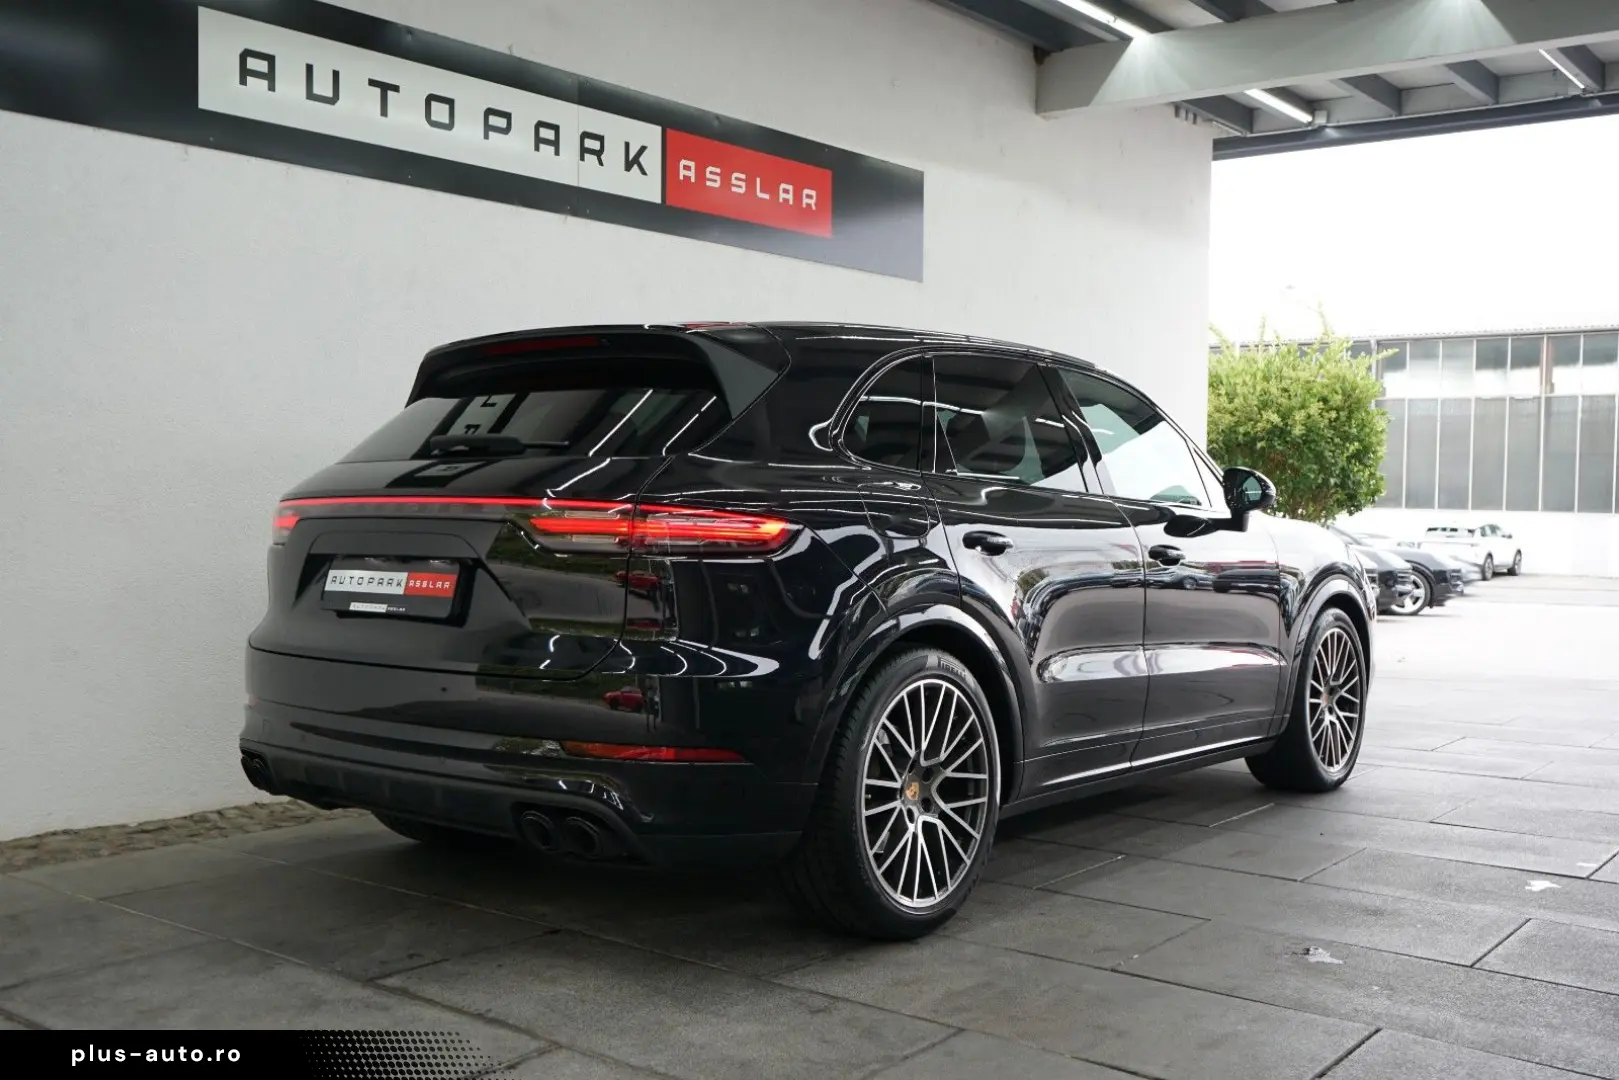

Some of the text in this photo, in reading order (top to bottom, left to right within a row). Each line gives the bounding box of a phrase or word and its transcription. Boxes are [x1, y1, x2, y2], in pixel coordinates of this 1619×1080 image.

[238, 47, 818, 212] AUTOPARK ASSLAR
[331, 575, 451, 589] AUTOPARK ASSLAR
